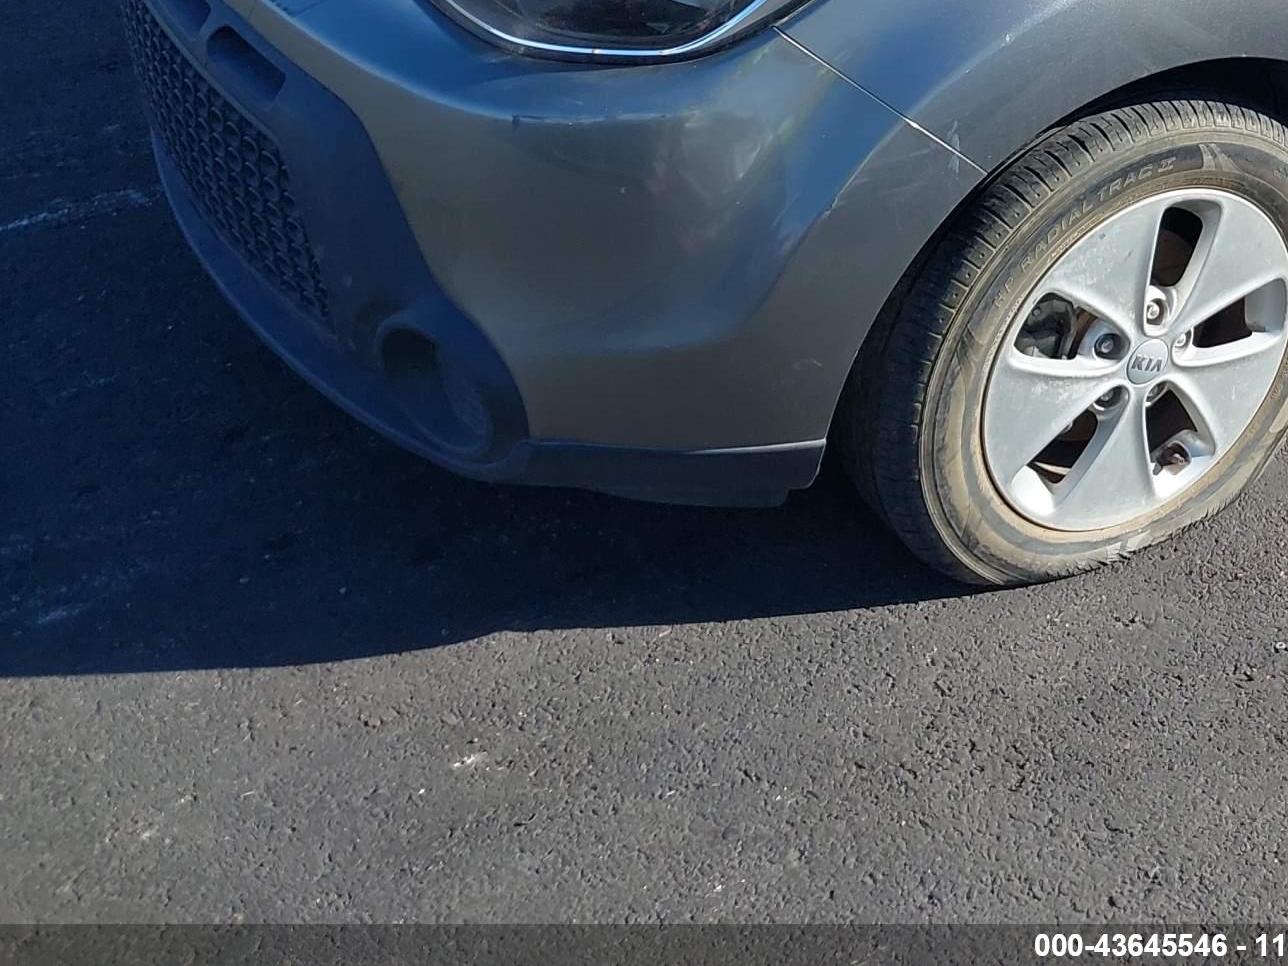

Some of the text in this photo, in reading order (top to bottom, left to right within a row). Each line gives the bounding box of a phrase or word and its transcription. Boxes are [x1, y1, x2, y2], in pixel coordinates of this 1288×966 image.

[1020, 202, 1094, 273] RADIAL
[1098, 165, 1152, 202] TRAC
[1131, 354, 1162, 372] KIA
